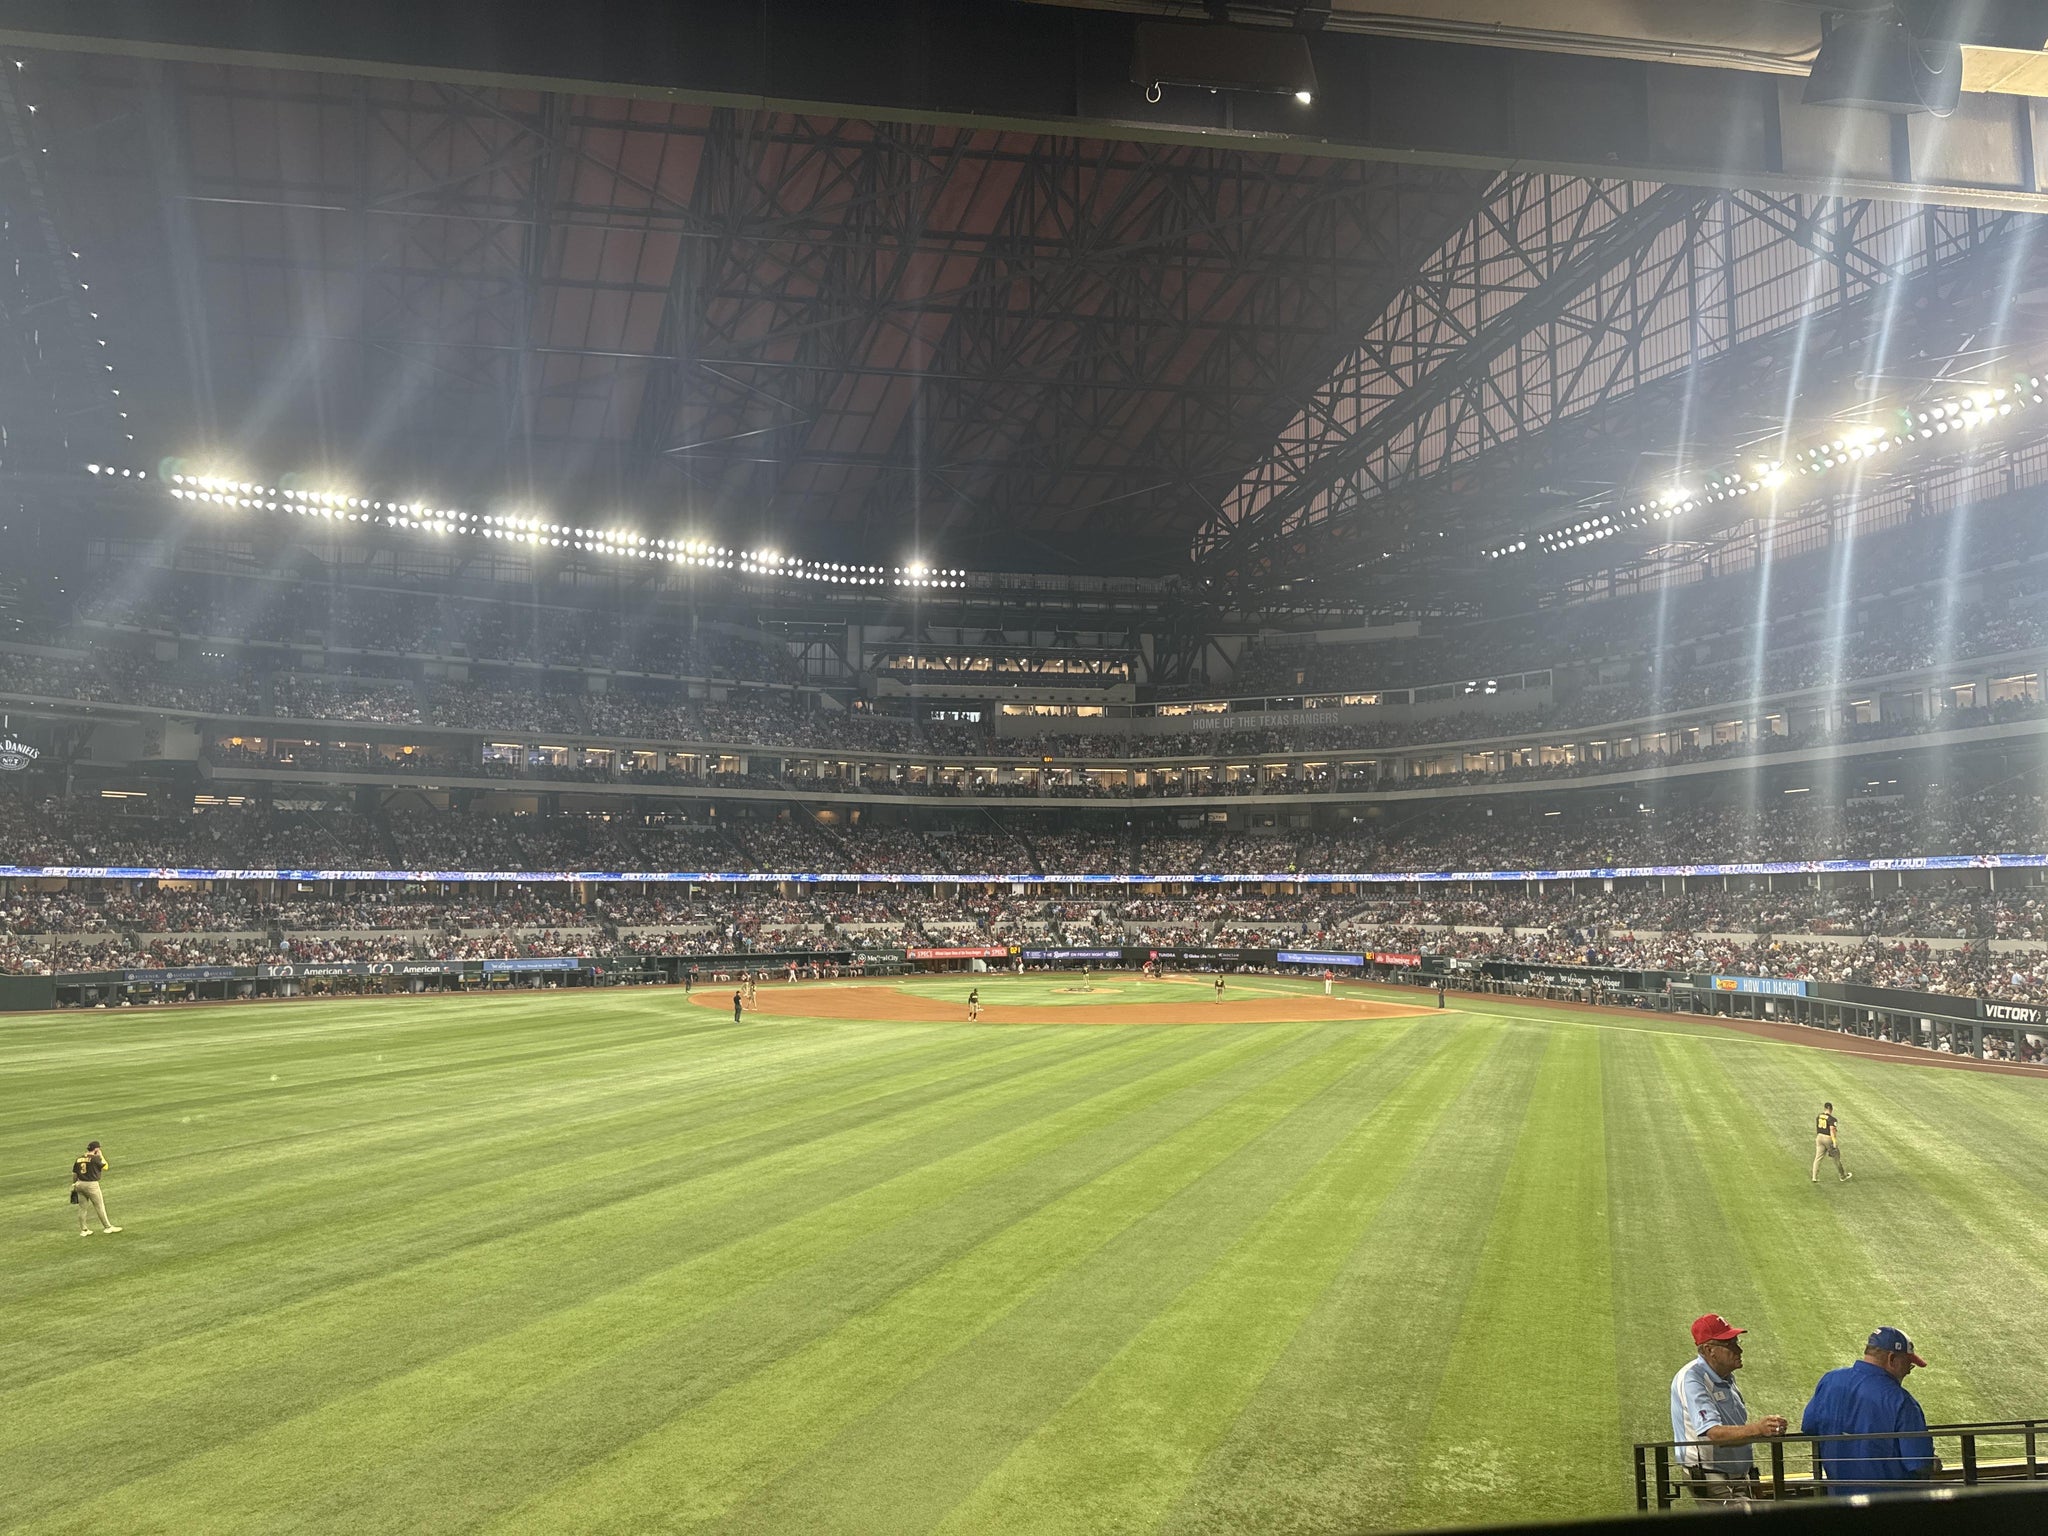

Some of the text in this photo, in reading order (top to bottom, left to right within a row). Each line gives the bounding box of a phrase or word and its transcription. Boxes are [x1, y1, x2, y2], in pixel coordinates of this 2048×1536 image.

[1193, 713, 1339, 730] HOME OF THE TEXAS RANGERS
[304, 968, 343, 976] American
[403, 965, 440, 973] American
[1567, 973, 1587, 988] Kroger
[1743, 979, 1800, 996] HOW TO NACHO!
[1985, 1004, 2037, 1022] VICTORY
[80, 1163, 87, 1174] 3
